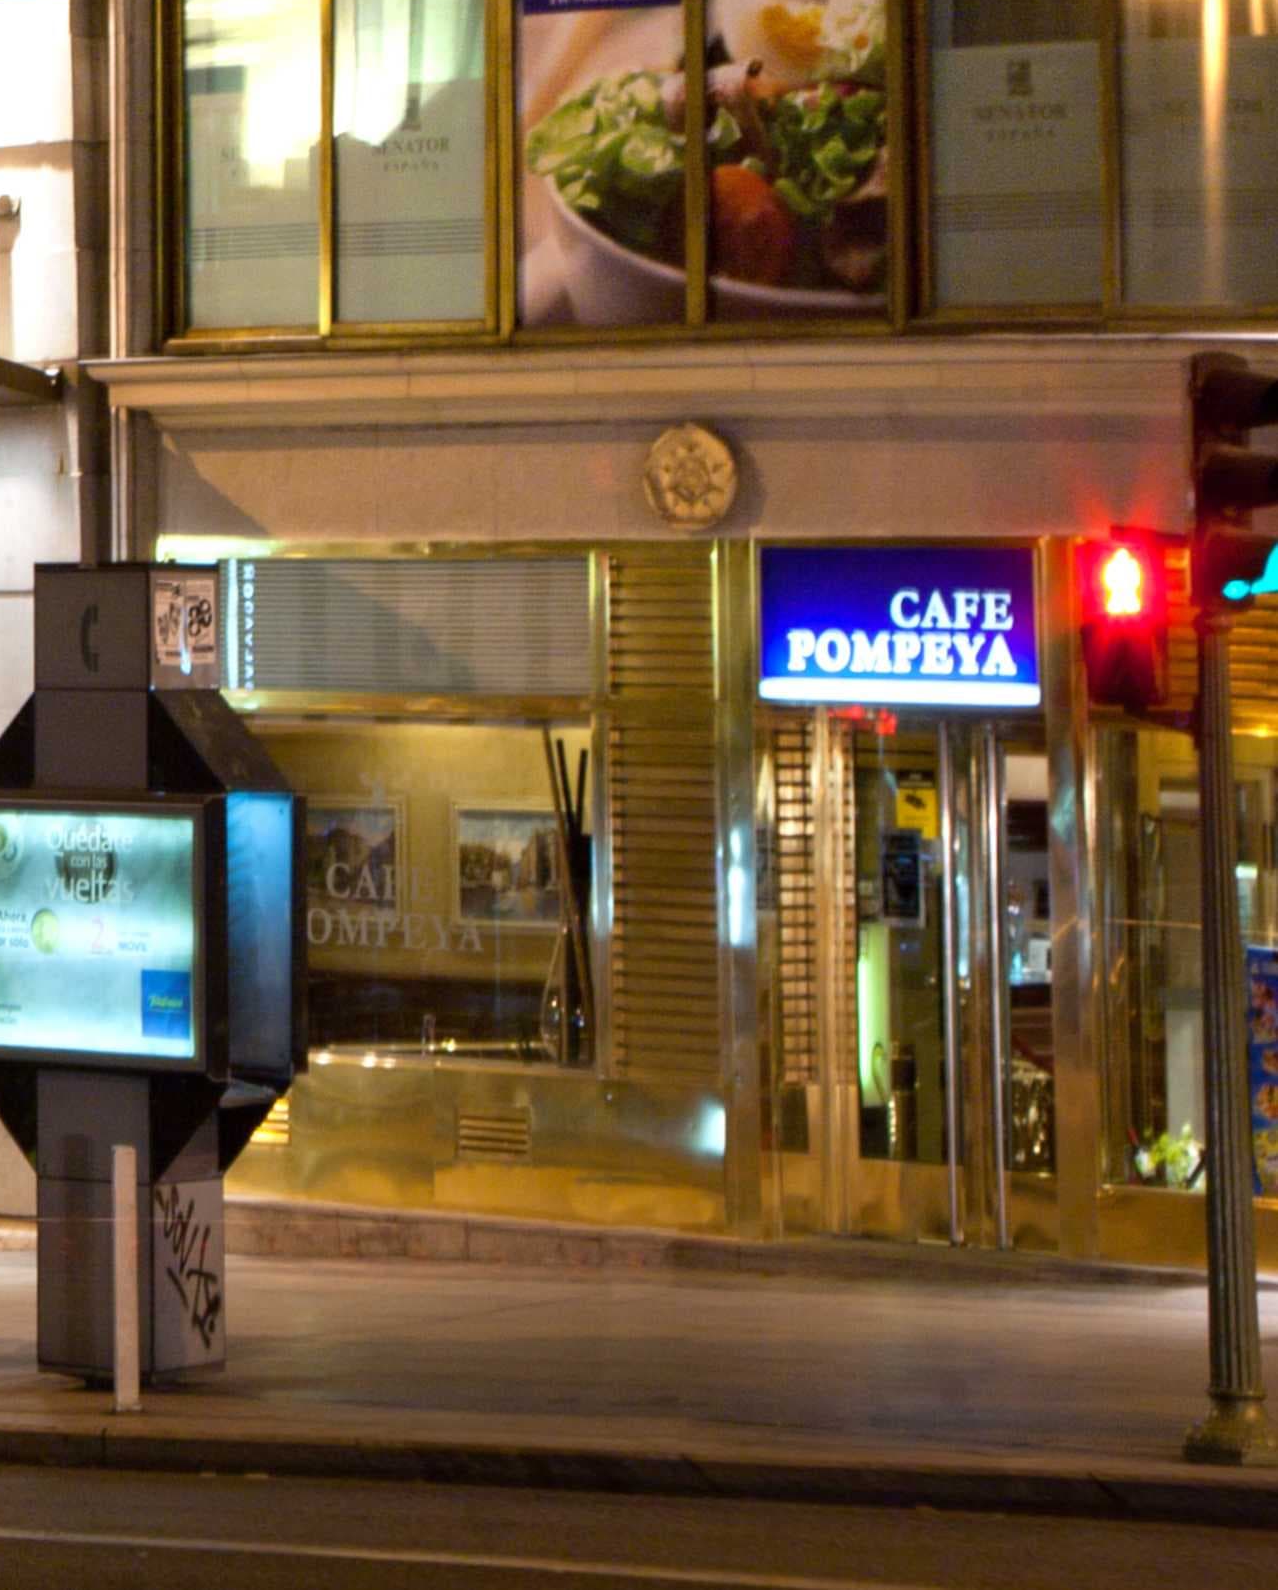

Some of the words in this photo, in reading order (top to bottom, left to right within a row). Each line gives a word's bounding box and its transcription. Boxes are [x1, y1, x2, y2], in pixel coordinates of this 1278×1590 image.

[889, 588, 1015, 631] CAFE
[786, 628, 1019, 678] POMPEYA
[45, 870, 134, 904] vueltas
[306, 906, 485, 953] OMPEYA
